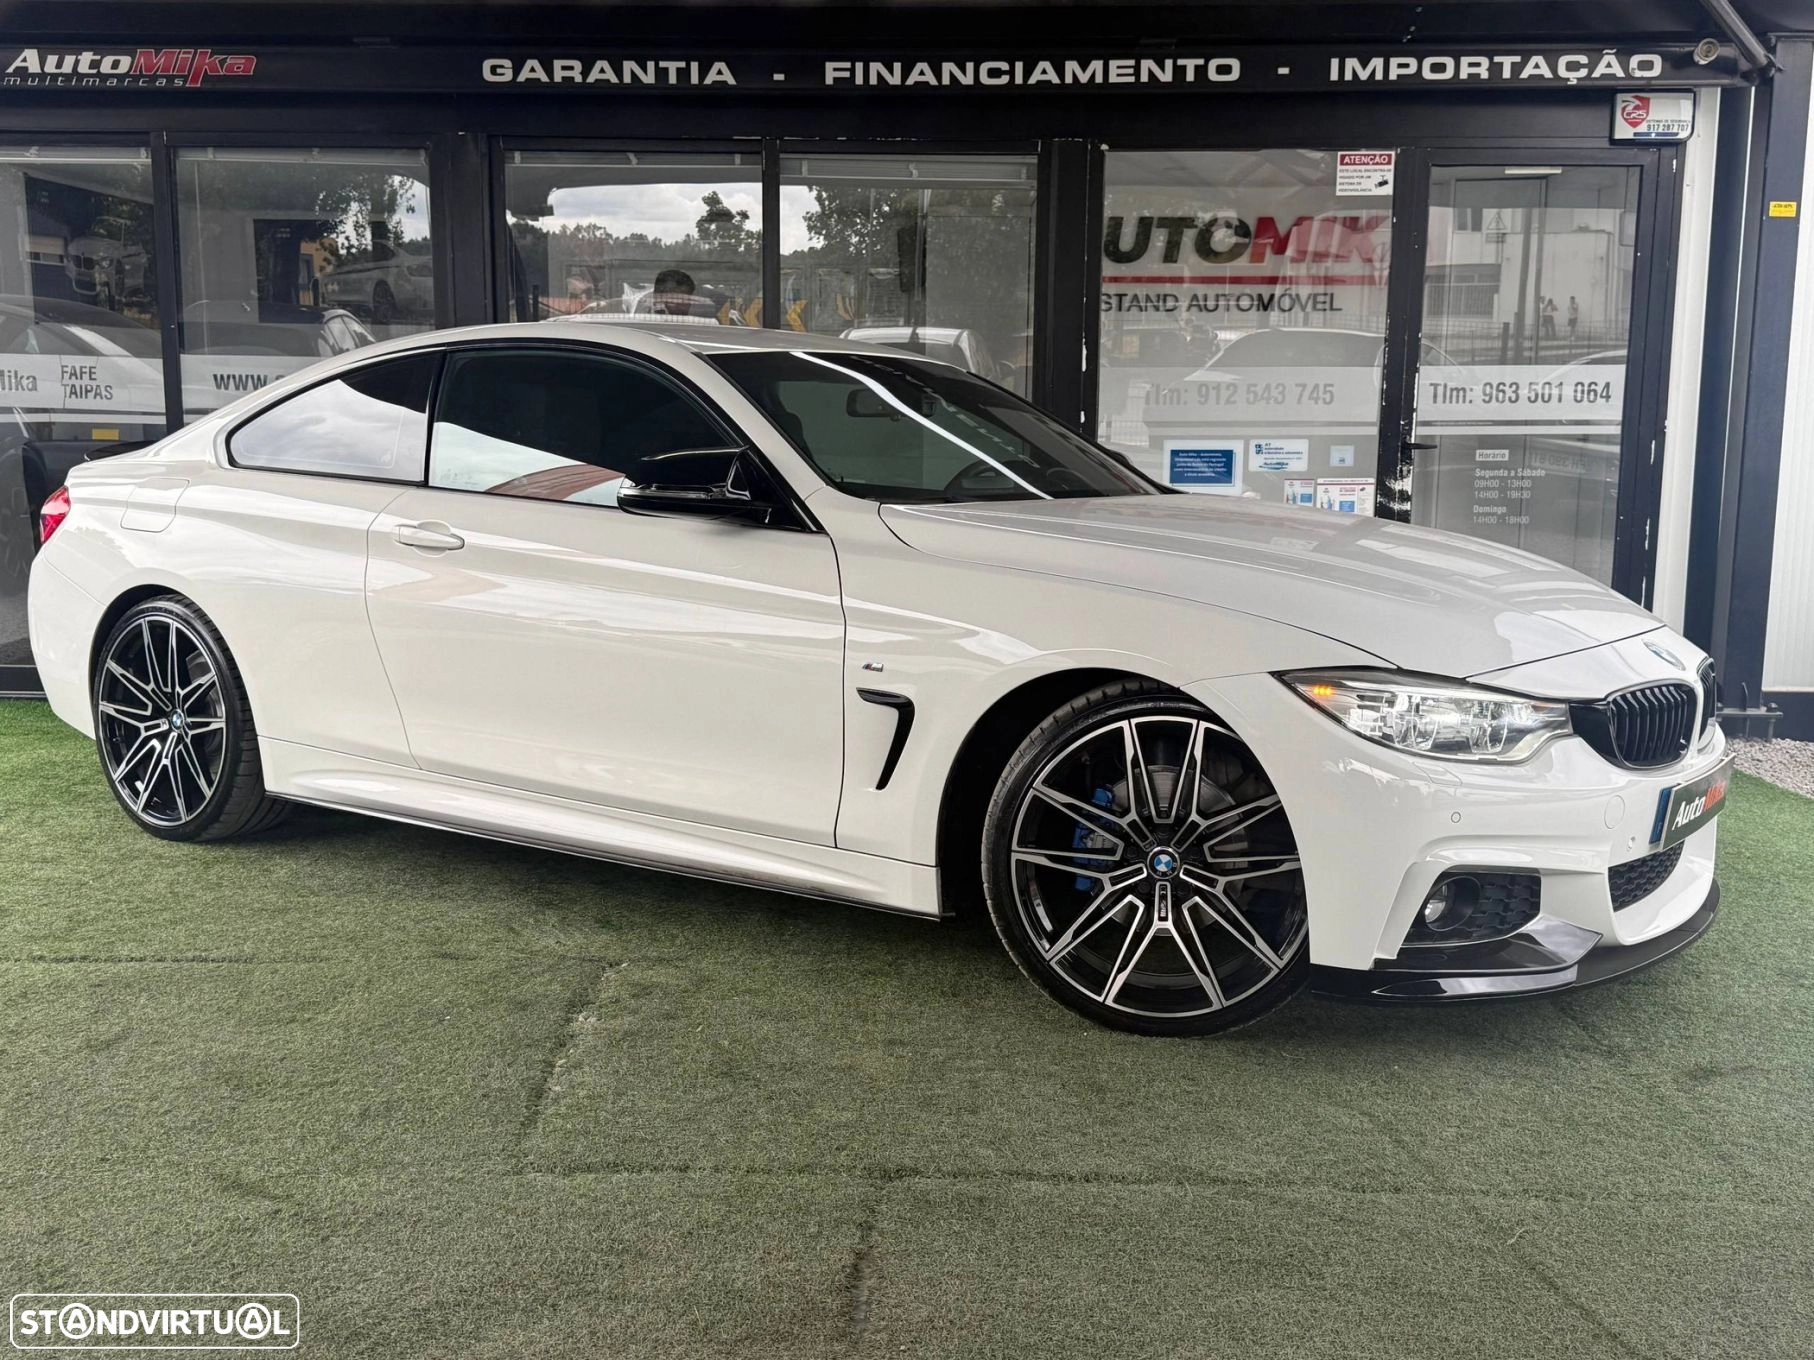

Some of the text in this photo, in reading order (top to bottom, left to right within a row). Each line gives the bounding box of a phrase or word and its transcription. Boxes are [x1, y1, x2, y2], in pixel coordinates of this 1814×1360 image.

[5, 49, 257, 87] AutoMika
[482, 58, 736, 86] GARANTIA
[824, 57, 1241, 86] FINANCIAMENTO
[1329, 49, 1663, 85] IMPORTAÇÃO
[4, 76, 184, 87] multimarcas
[1646, 124, 1689, 132] 917 287 707
[1343, 154, 1389, 165] ATENÇÃO
[1101, 288, 1342, 313] STAND AUTOMÓVEL
[61, 365, 97, 380] FAFE
[61, 384, 113, 400] TAIPAS
[1198, 383, 1238, 405] 912
[1246, 383, 1286, 405] 543
[1295, 383, 1334, 405] 745
[1429, 381, 1612, 404] Tlm: 963 501 064
[1474, 468, 1508, 478] Segunda
[1517, 467, 1546, 477] Sábado
[1474, 480, 1500, 488] 09H00
[1474, 490, 1499, 499] 14H00
[1473, 505, 1507, 514] Domingo
